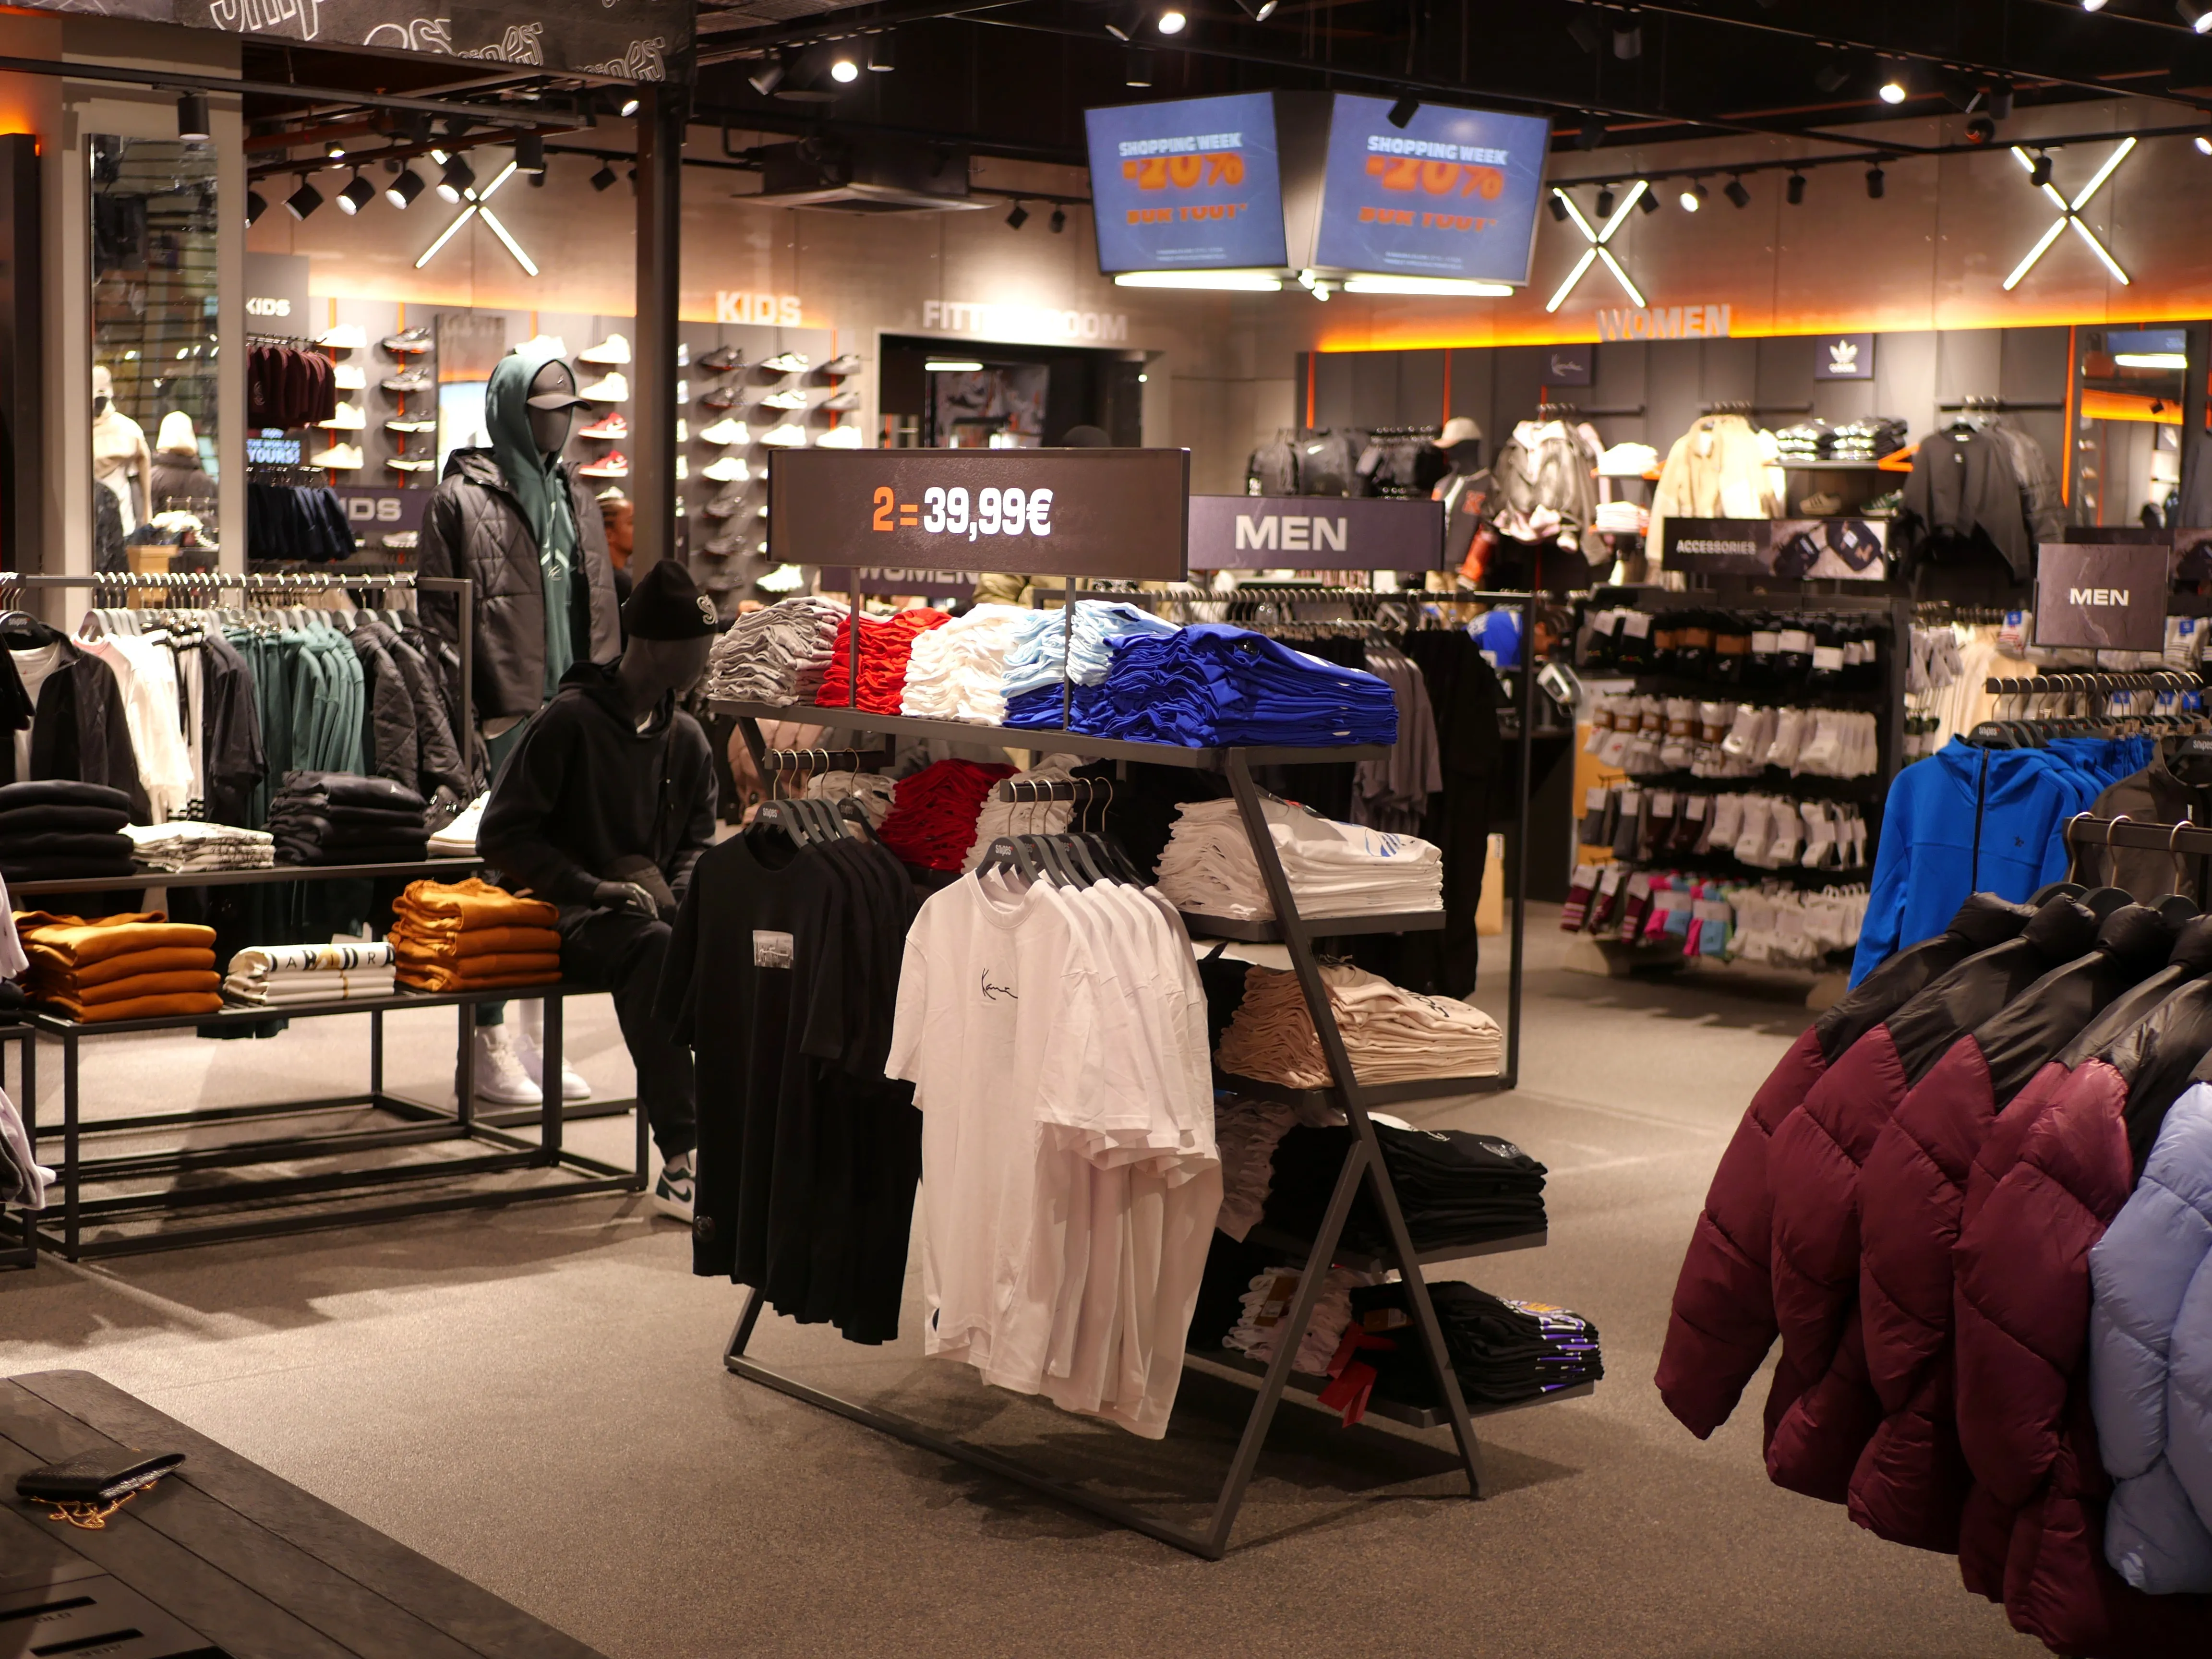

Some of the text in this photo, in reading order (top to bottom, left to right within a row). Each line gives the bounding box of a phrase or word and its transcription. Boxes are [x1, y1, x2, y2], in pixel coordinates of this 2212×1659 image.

[1118, 132, 1242, 156] SHOPPING WEEK
[1367, 135, 1509, 165] SHOPPING WEEK
[716, 290, 802, 328] KIDS
[1596, 304, 1729, 342] WOMEN
[338, 497, 402, 521] IDS
[1235, 515, 1347, 551] MEN
[1676, 540, 1756, 555] ACCESSORIES
[2070, 588, 2129, 606] MEN
